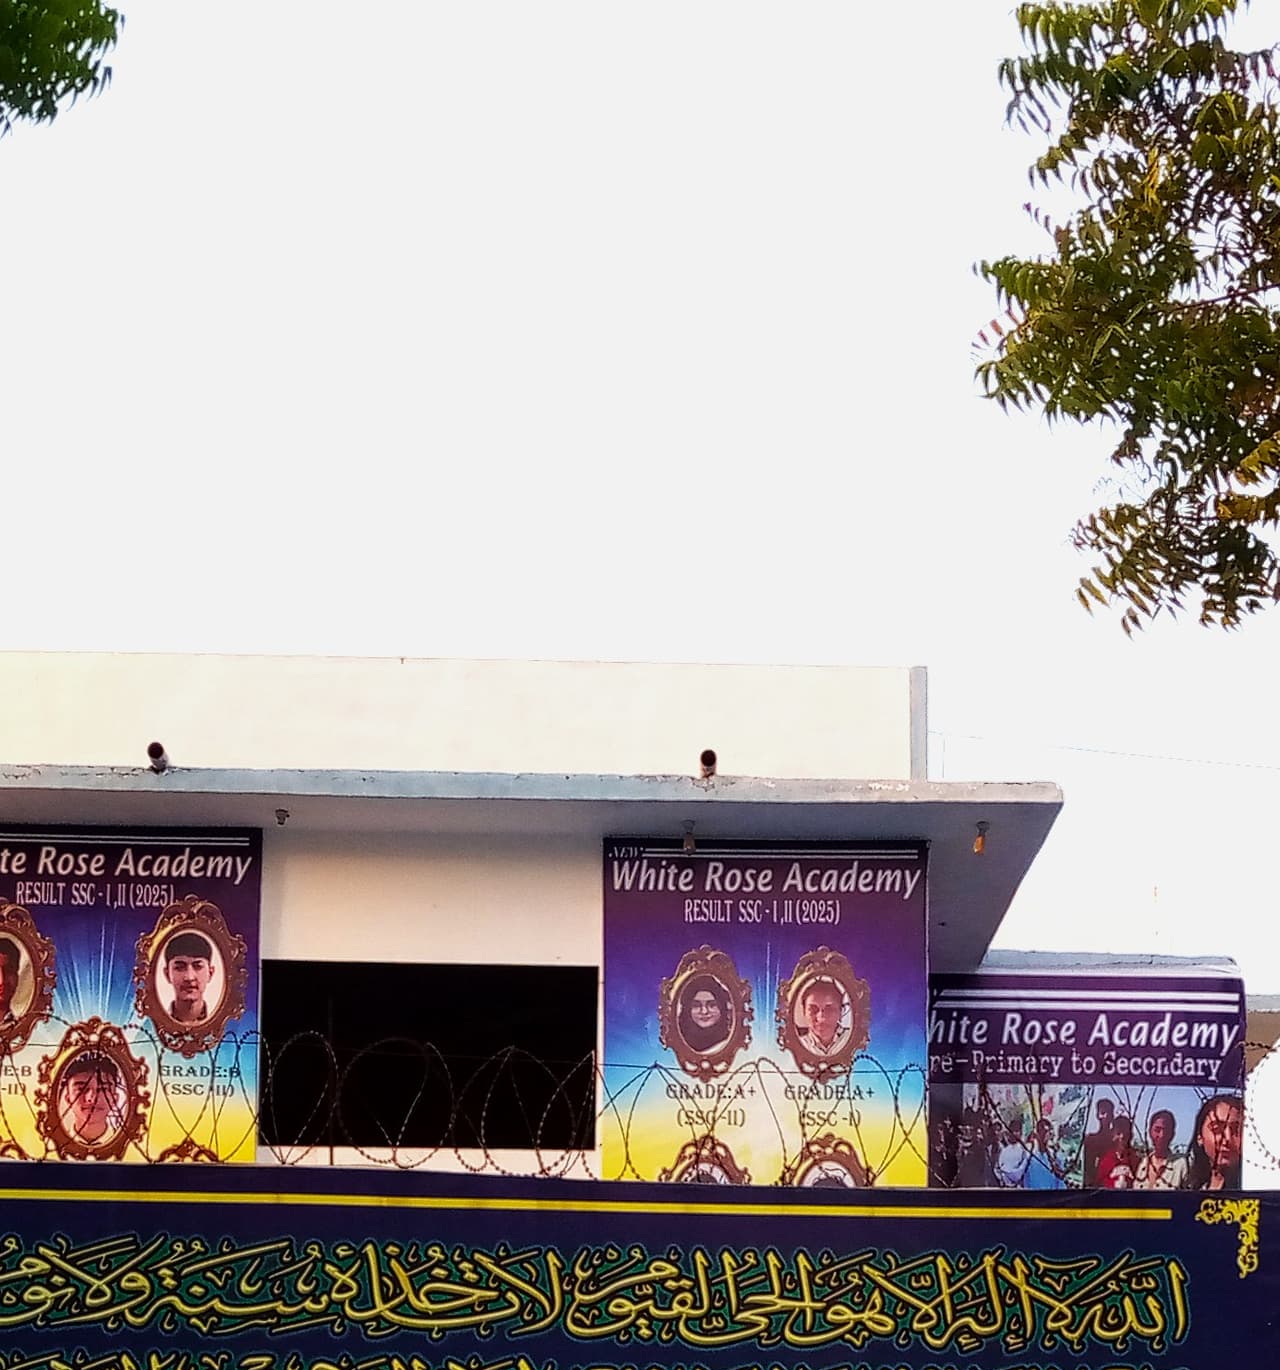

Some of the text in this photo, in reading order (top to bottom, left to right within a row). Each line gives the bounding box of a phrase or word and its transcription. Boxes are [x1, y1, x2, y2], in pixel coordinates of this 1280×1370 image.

[37, 846, 105, 877] Rose
[115, 848, 253, 885] Academy
[613, 859, 921, 899] White Rose Academy
[16, 881, 66, 905] RESULT
[684, 899, 733, 922] RESULT
[928, 1010, 1239, 1056] hite Rose Academy
[929, 1047, 1222, 1079] re-Primary to Secondary
